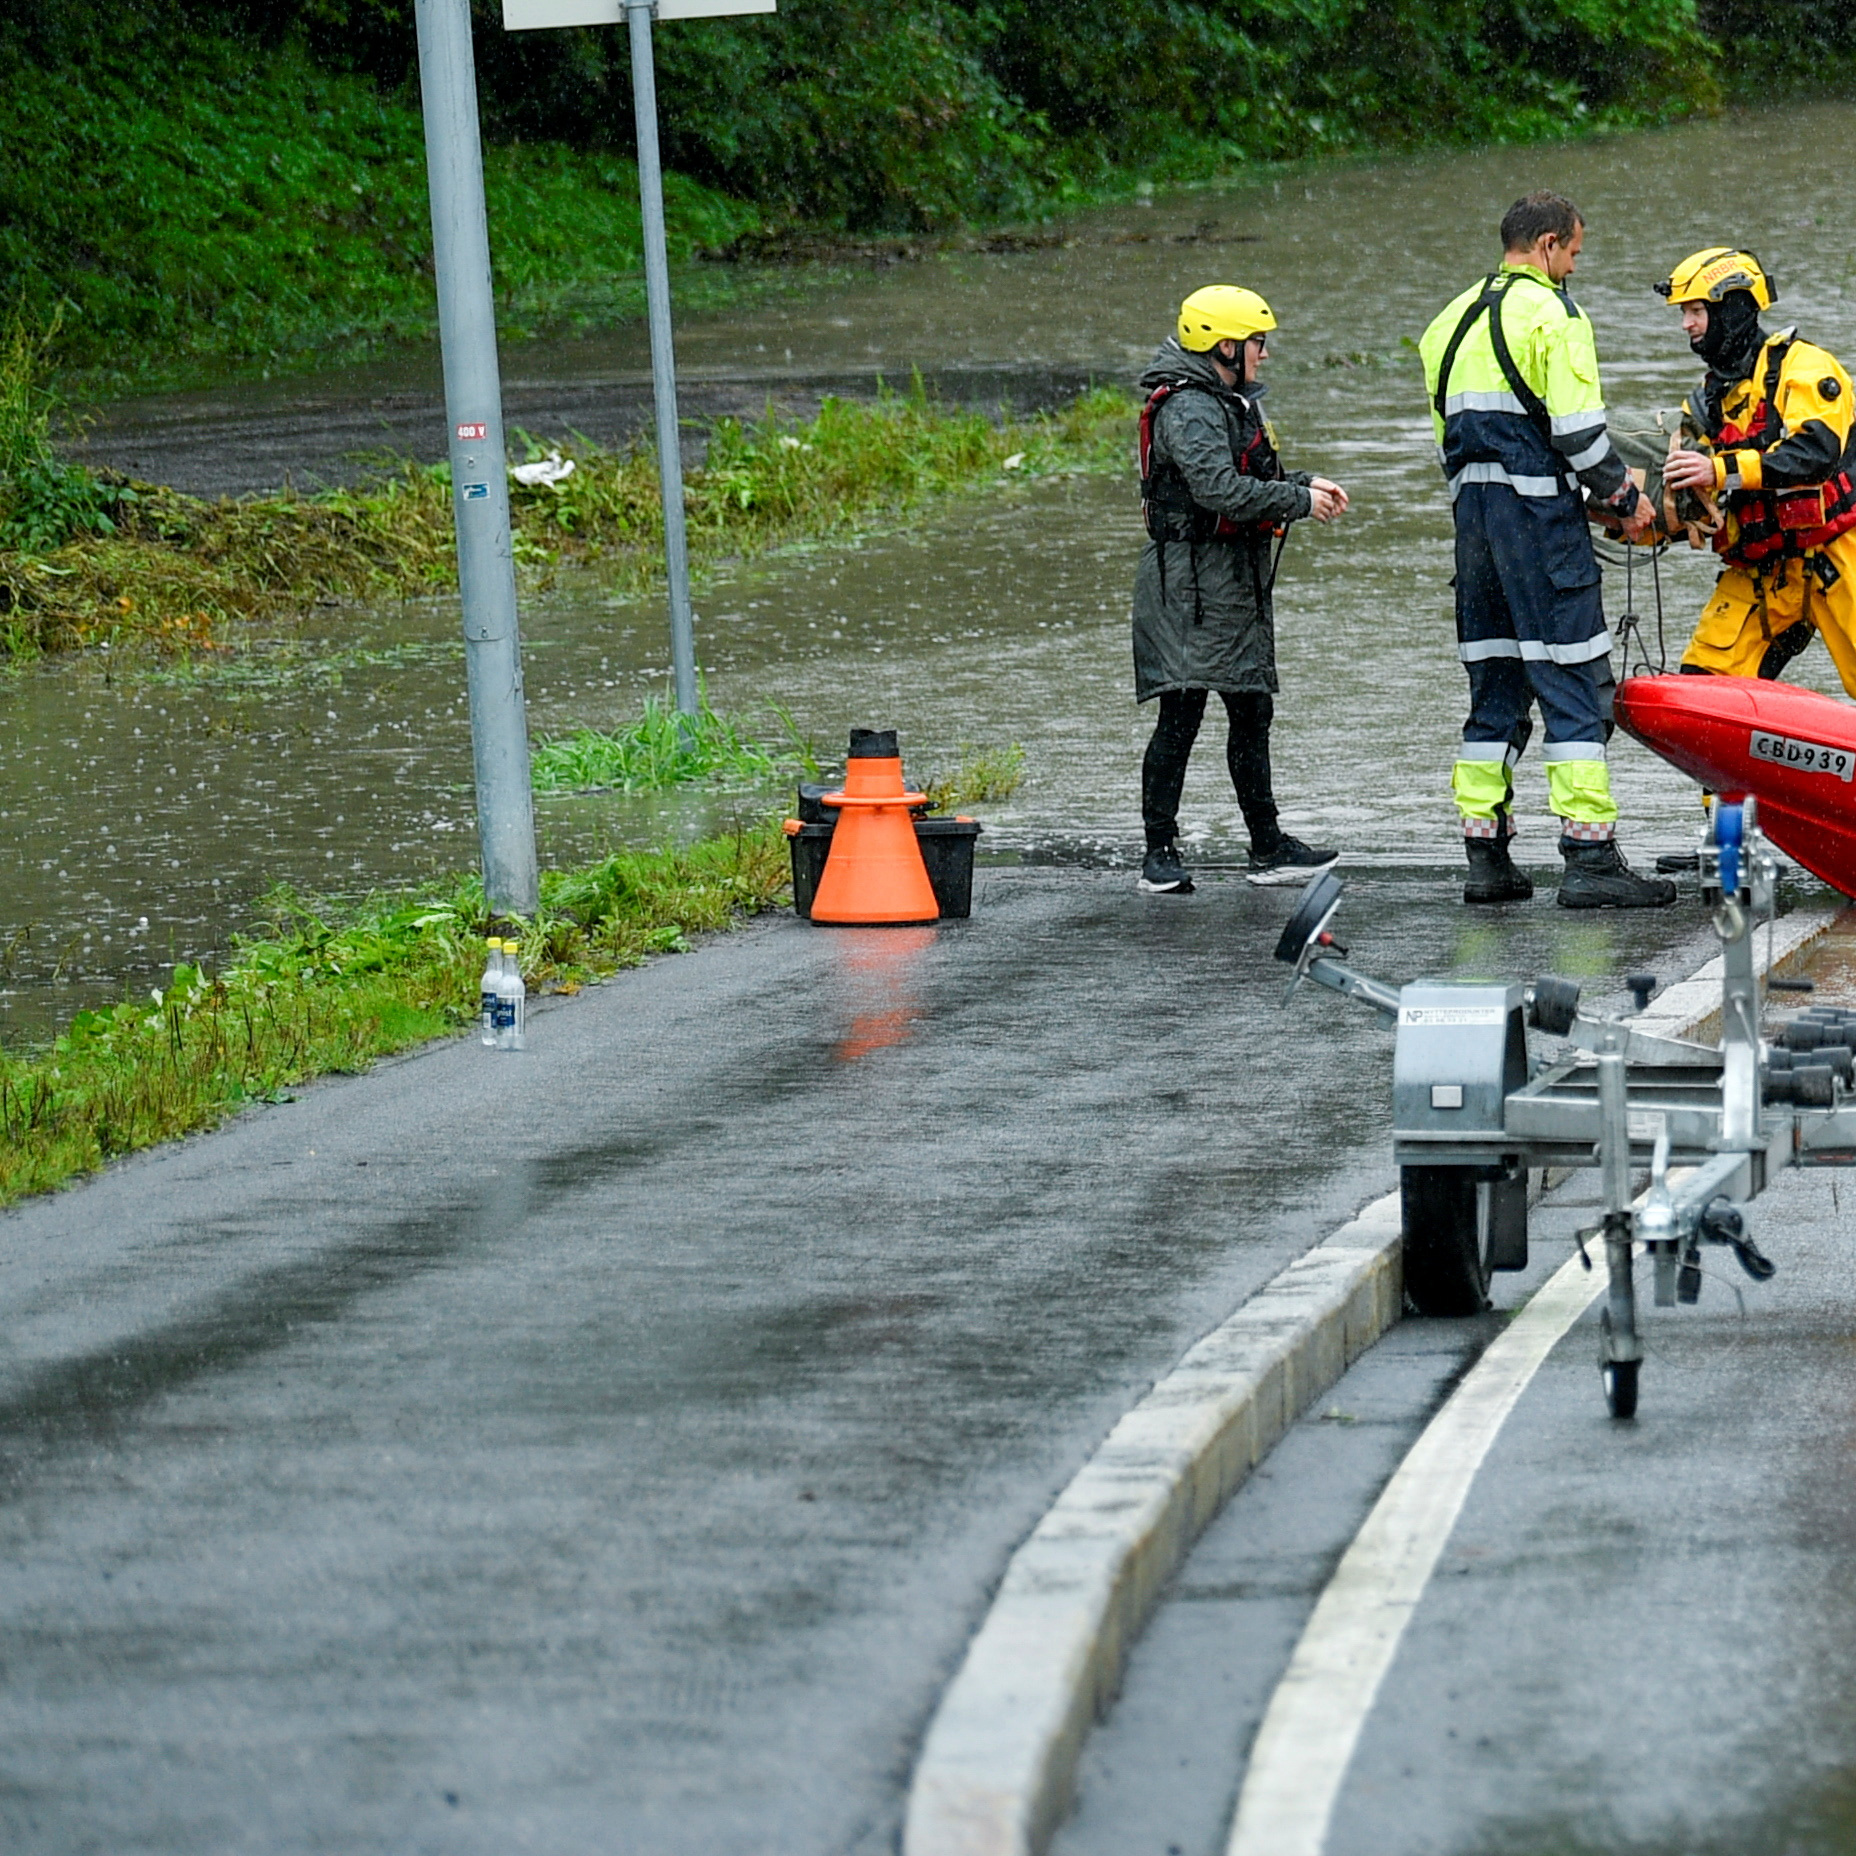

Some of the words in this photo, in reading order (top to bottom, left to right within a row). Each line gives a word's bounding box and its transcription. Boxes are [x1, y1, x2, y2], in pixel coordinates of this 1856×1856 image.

[1702, 259, 1738, 284] NRBR
[458, 426, 476, 437] 400
[478, 426, 485, 436] V
[1757, 737, 1847, 773] CBD939
[1406, 1010, 1423, 1024] NP
